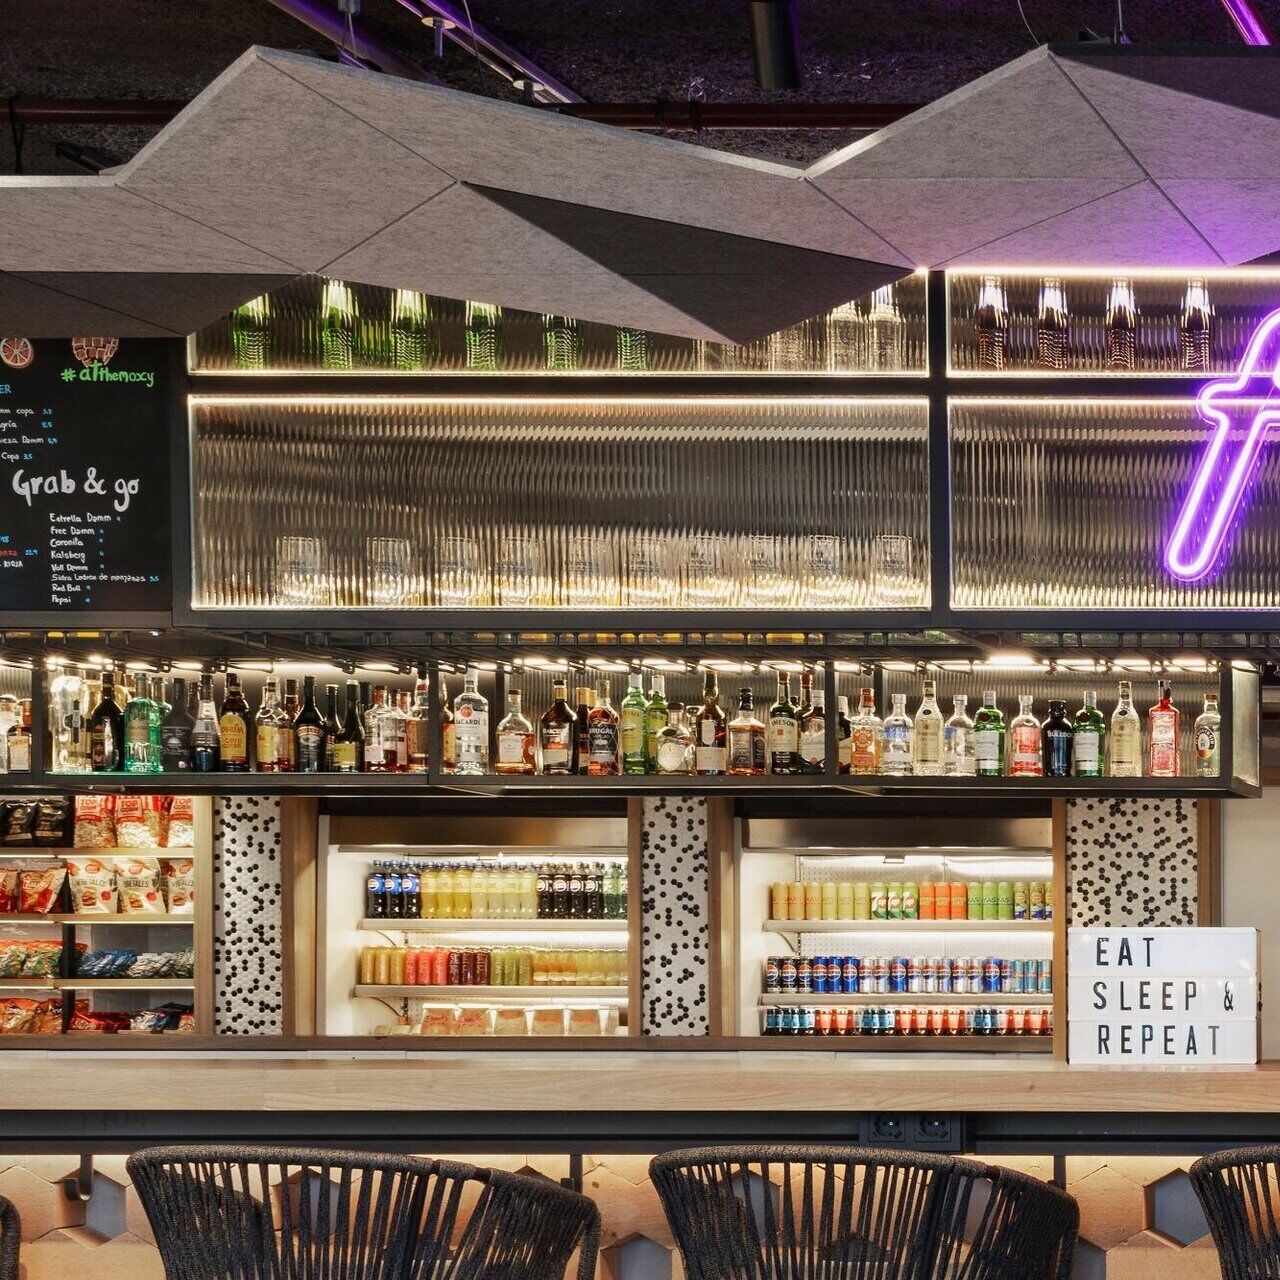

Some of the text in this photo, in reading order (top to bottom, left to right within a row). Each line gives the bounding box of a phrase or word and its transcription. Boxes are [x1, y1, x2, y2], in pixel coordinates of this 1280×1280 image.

[12, 467, 140, 512] Grab & go
[50, 513, 82, 523] Estrella
[87, 513, 112, 522] Damm
[51, 526, 95, 535] Free Damm
[50, 538, 84, 548] Coronita
[52, 584, 66, 592] Red
[1096, 937, 1155, 967] EAT
[1092, 981, 1197, 1011] SLEEP
[1097, 1025, 1221, 1055] REPEAT
